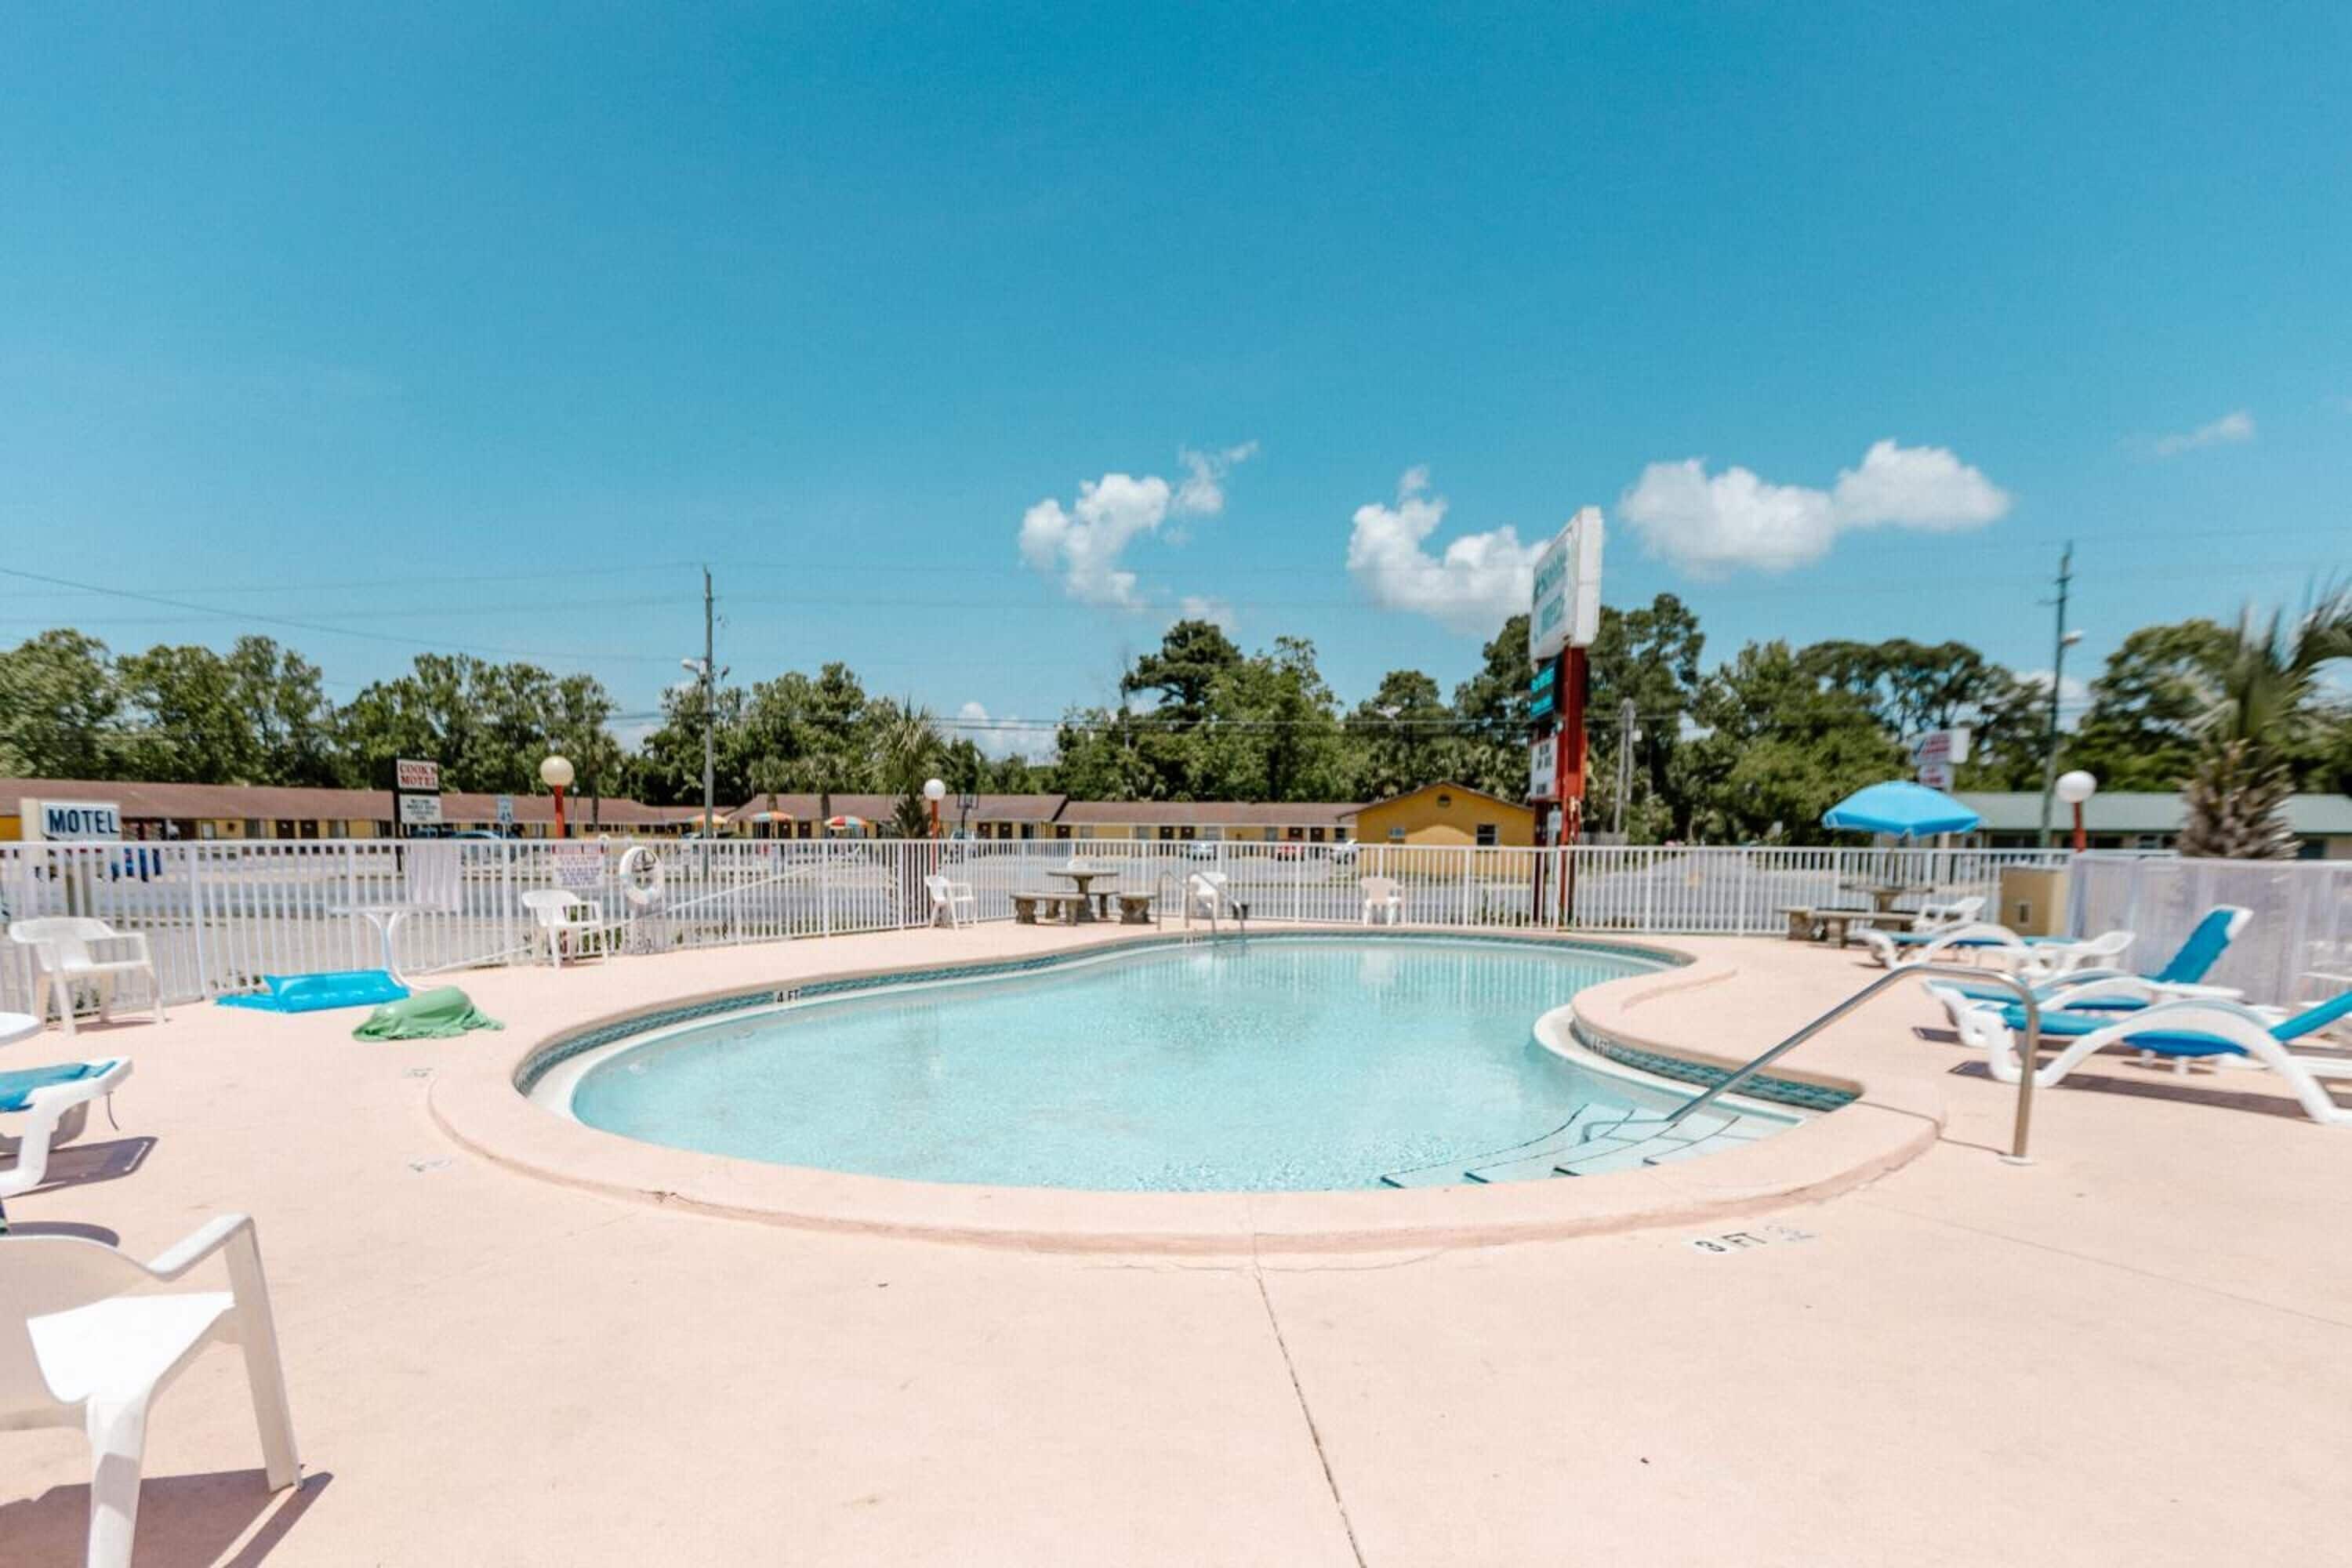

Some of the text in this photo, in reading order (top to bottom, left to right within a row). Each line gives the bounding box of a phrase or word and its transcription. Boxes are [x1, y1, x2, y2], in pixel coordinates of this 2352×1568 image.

[401, 775, 437, 787] MOTEL
[49, 808, 119, 833] MOTEL
[777, 989, 800, 1003] 4 FT
[1722, 1232, 1768, 1247] FT
